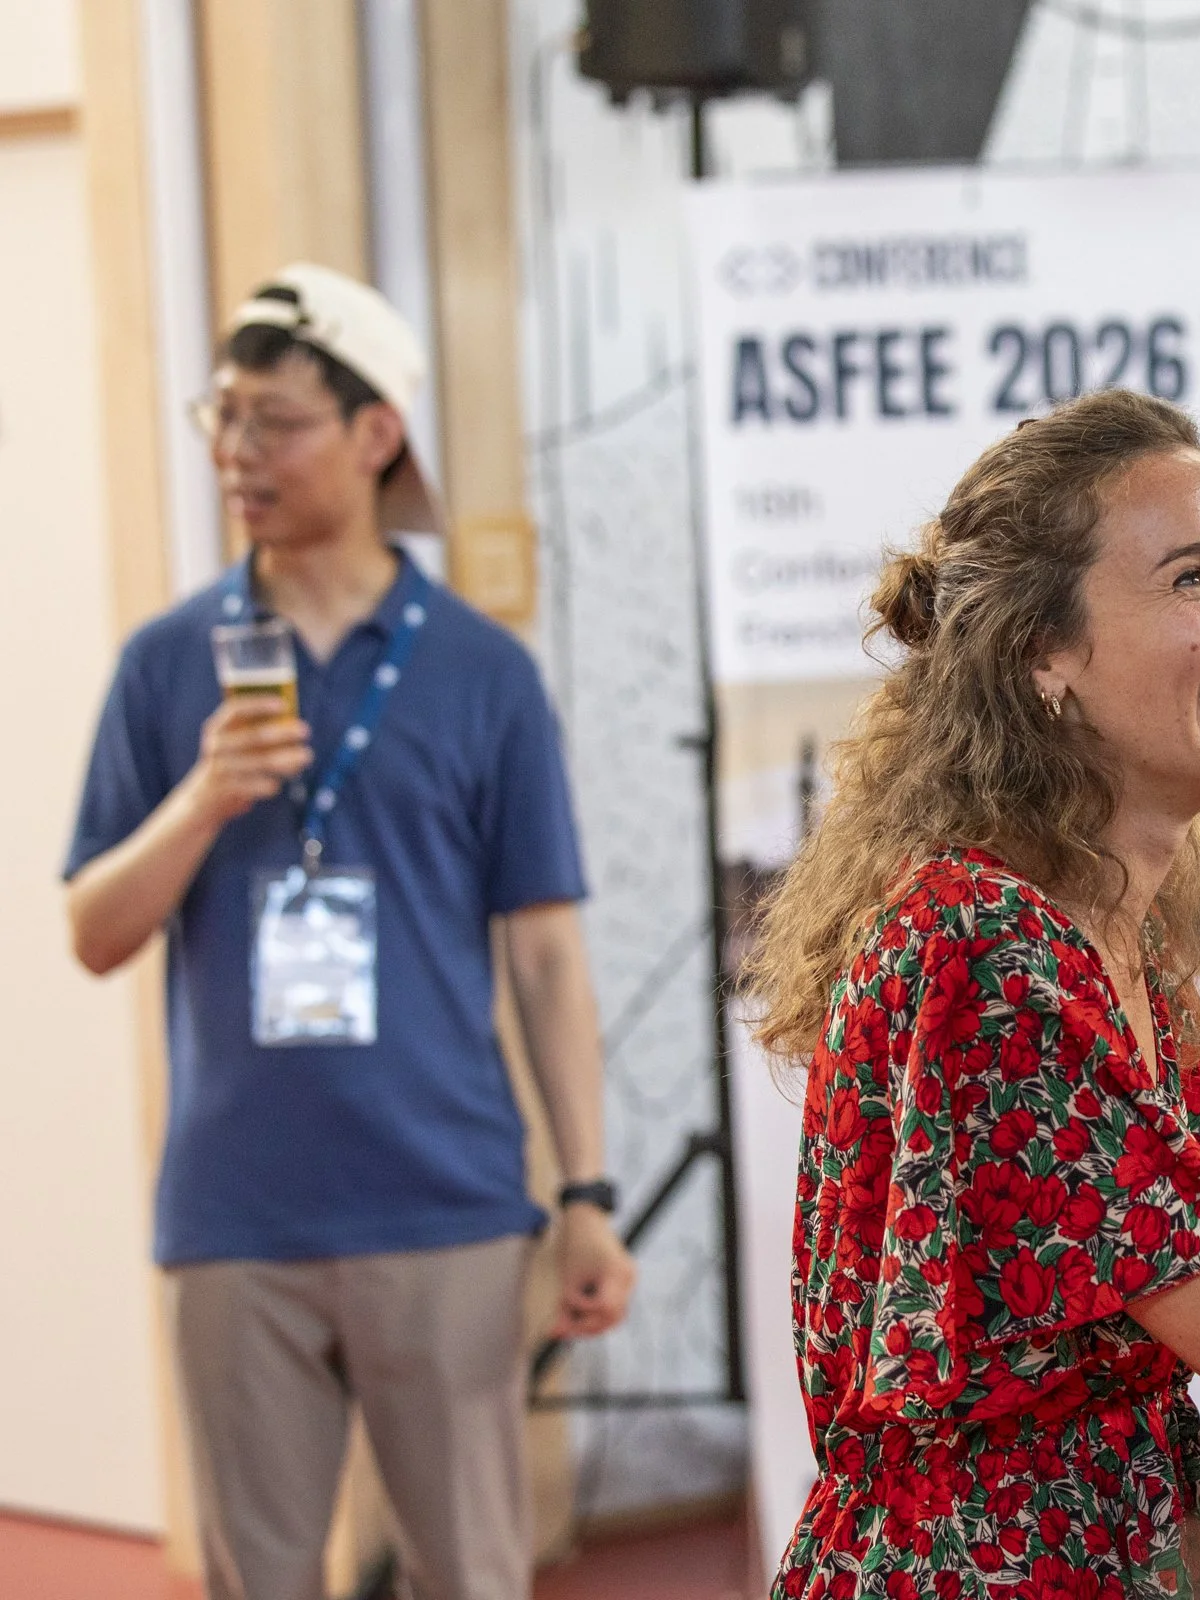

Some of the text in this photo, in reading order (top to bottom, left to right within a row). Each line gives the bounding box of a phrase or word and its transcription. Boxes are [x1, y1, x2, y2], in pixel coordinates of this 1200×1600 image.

[812, 235, 1028, 287] CONFERENCE
[731, 315, 1188, 426] ASFEE 2026
